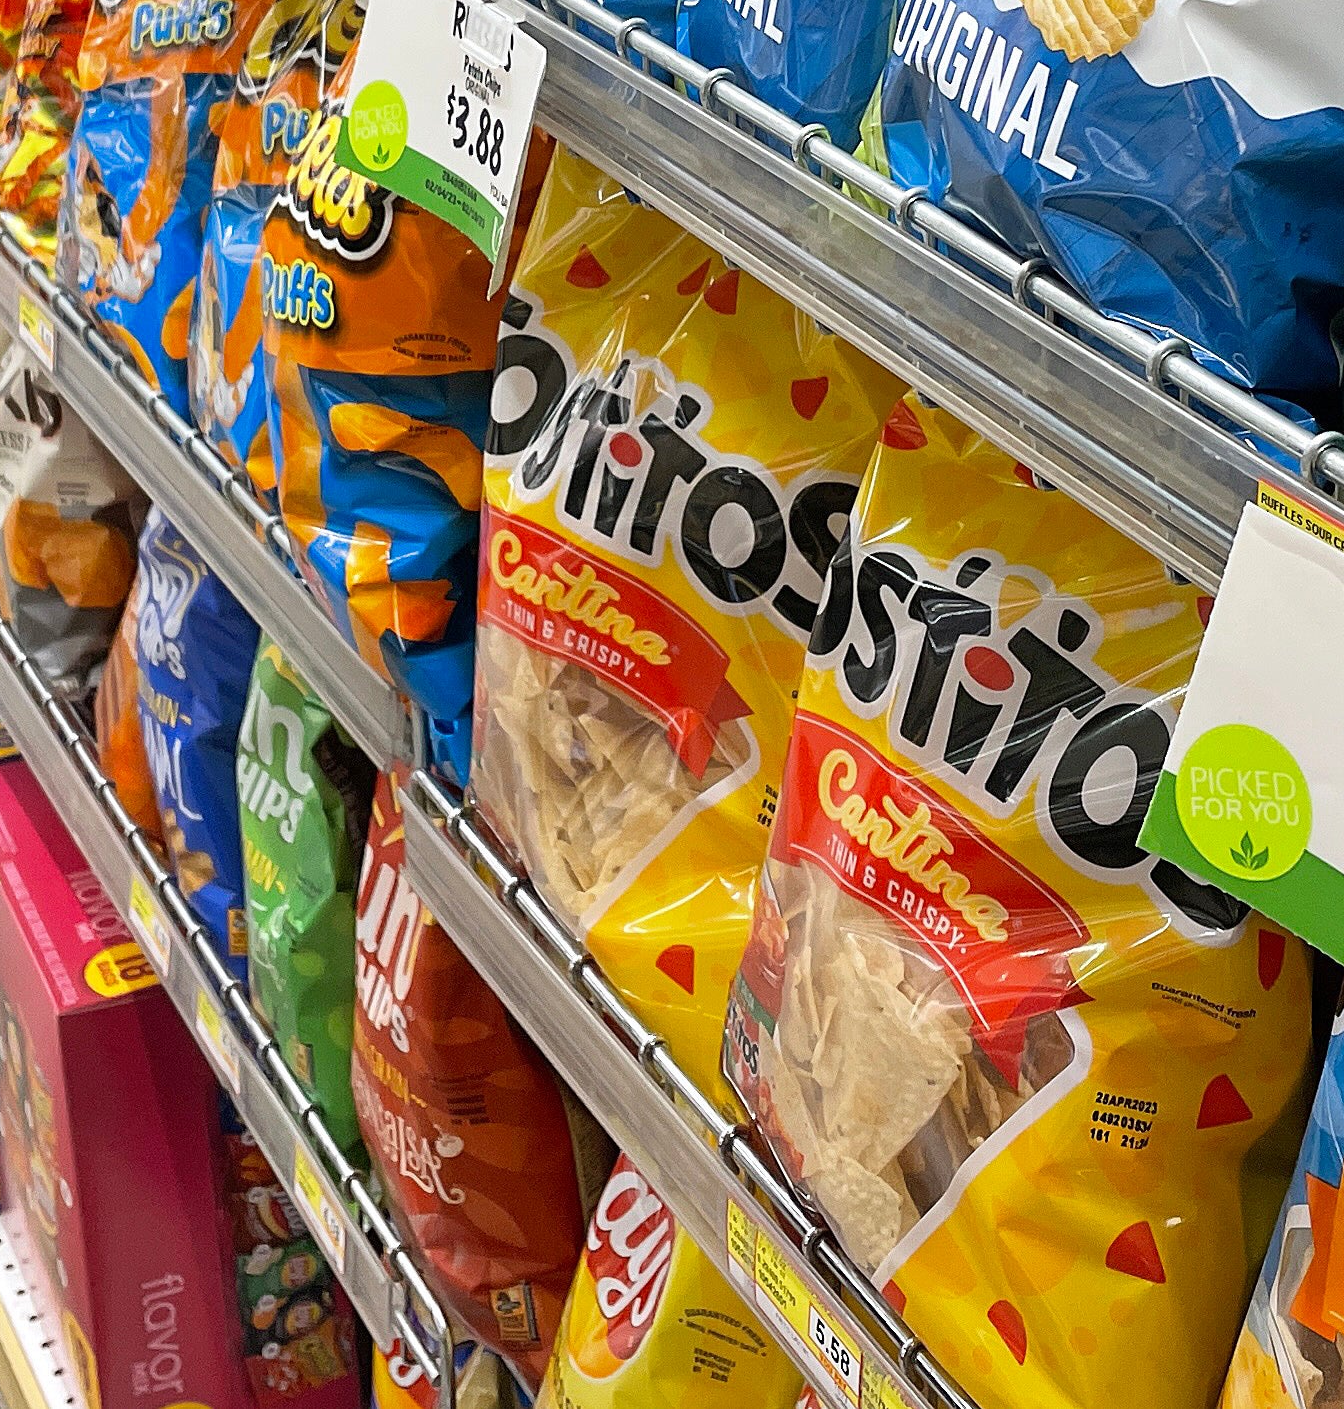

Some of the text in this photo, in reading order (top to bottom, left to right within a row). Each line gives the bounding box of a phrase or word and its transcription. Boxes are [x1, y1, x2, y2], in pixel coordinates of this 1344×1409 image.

[464, 54, 502, 97] Potato Chips
[354, 103, 402, 126] PICKED
[447, 84, 505, 177] $3.88
[1260, 491, 1304, 527] RUFFLES
[1305, 517, 1333, 544] SOUR
[485, 528, 673, 667] Cantina
[504, 600, 638, 680] THIN & CRISPY
[242, 758, 303, 844] HIPS
[1190, 764, 1297, 804] PICKED
[1190, 797, 1300, 828] FOR YOU
[818, 749, 1009, 943] Cantina
[827, 838, 965, 949] THIN & CRISPY
[1227, 1006, 1257, 1019] fresh
[815, 1318, 851, 1377] 5.58
